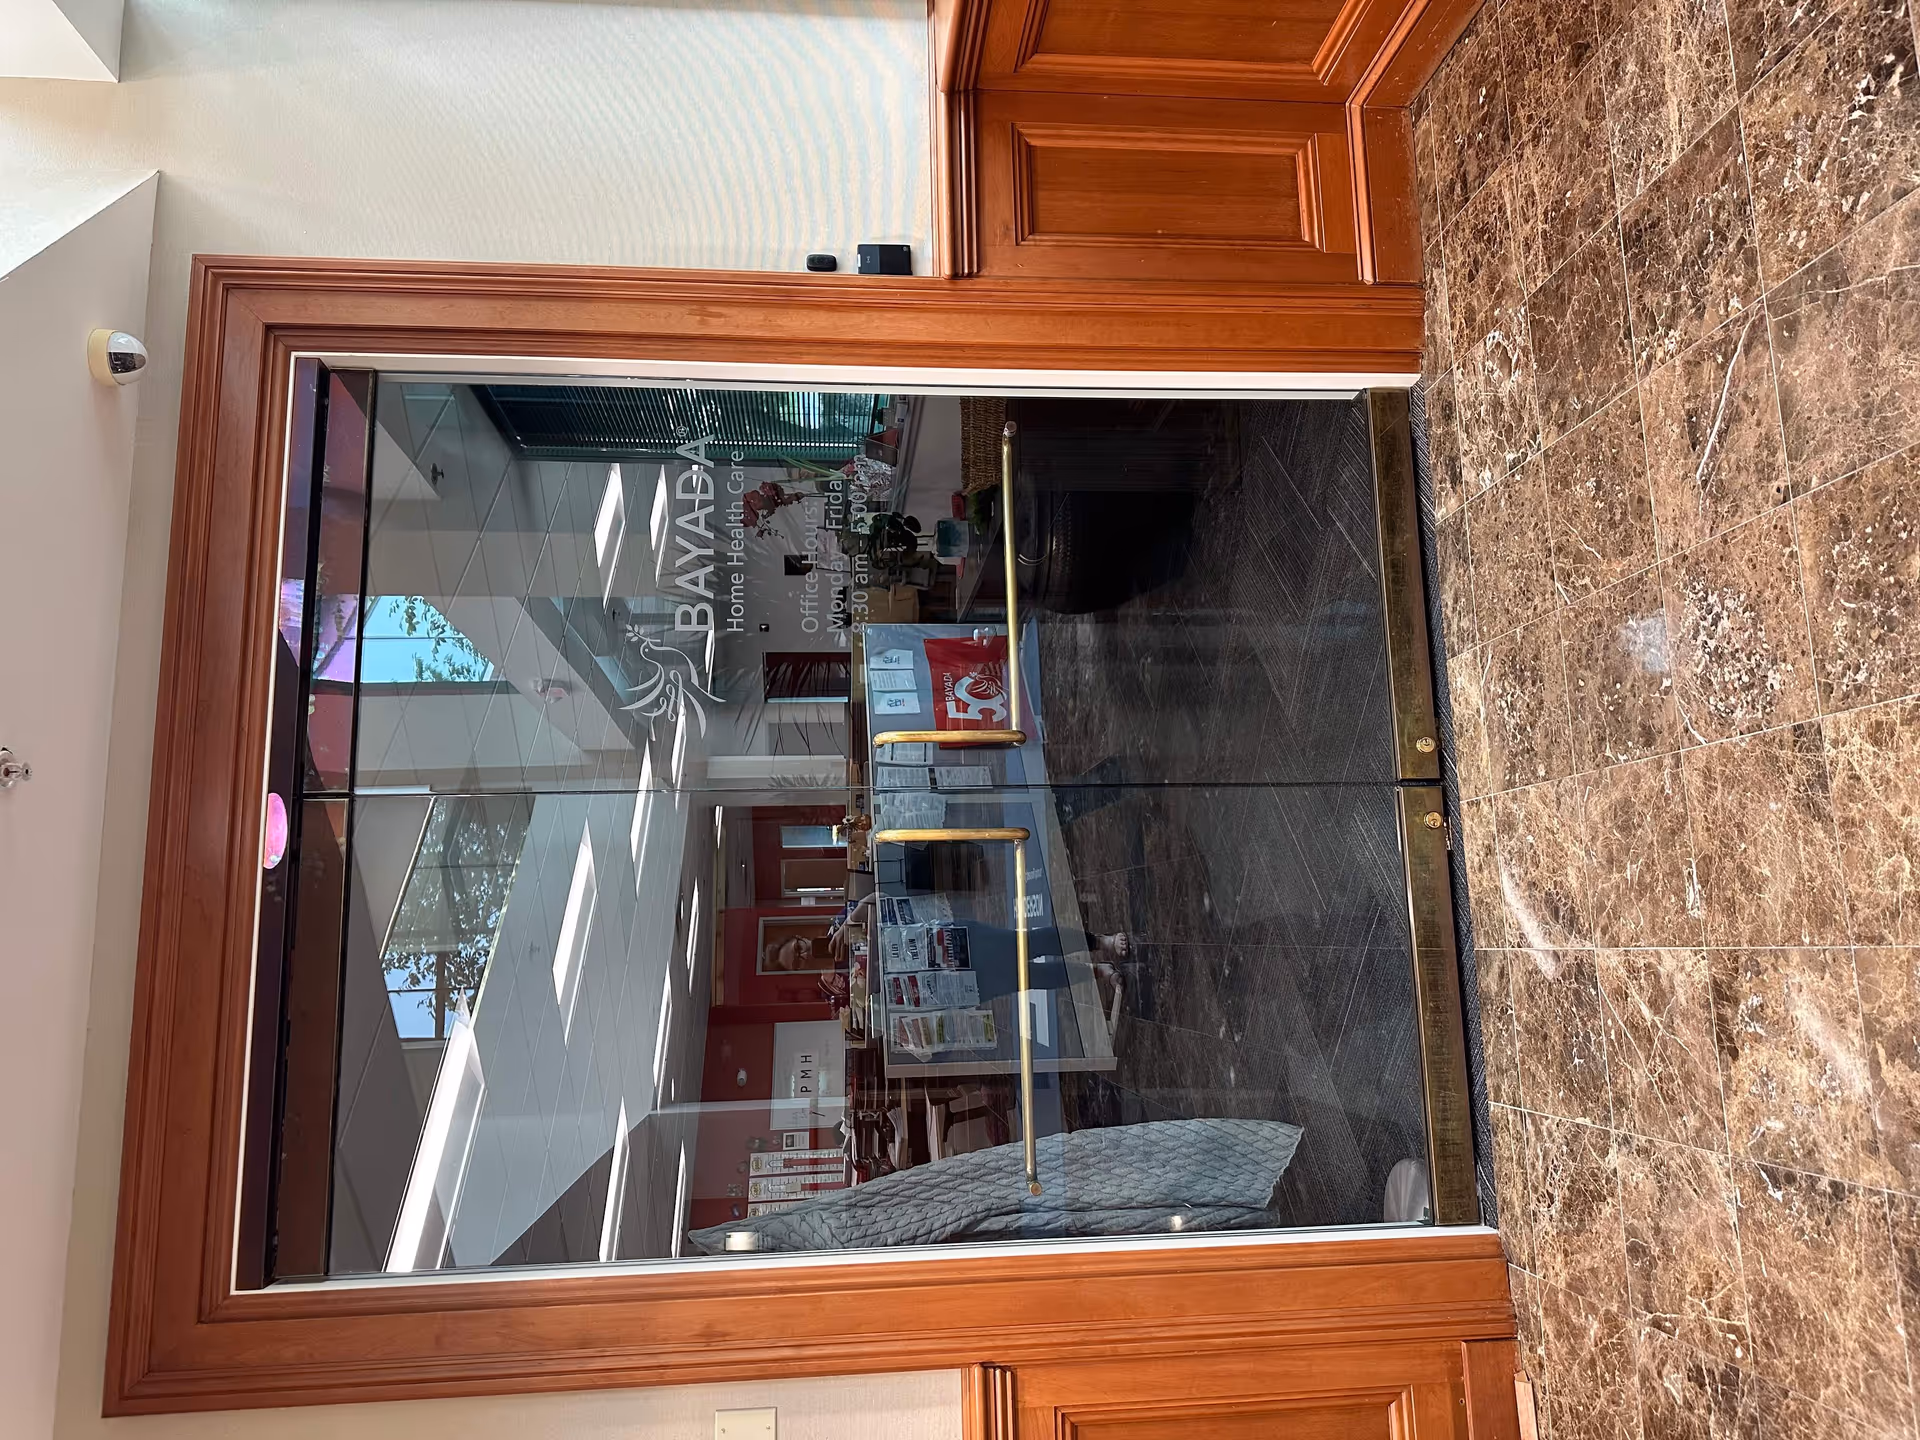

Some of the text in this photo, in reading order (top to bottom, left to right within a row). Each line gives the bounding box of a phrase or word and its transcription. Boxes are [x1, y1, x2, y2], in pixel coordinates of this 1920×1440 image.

[853, 454, 873, 487] pm
[825, 467, 847, 529] Friday
[850, 492, 869, 534] 5:00
[725, 450, 744, 632] Home Health Care
[801, 501, 819, 634] Office Hours:
[854, 553, 869, 585] am
[826, 551, 848, 633] Monday
[850, 591, 869, 633] 8:30
[942, 672, 955, 702] BAYADA
[945, 676, 1008, 722] 50
[907, 938, 918, 951] LAW
